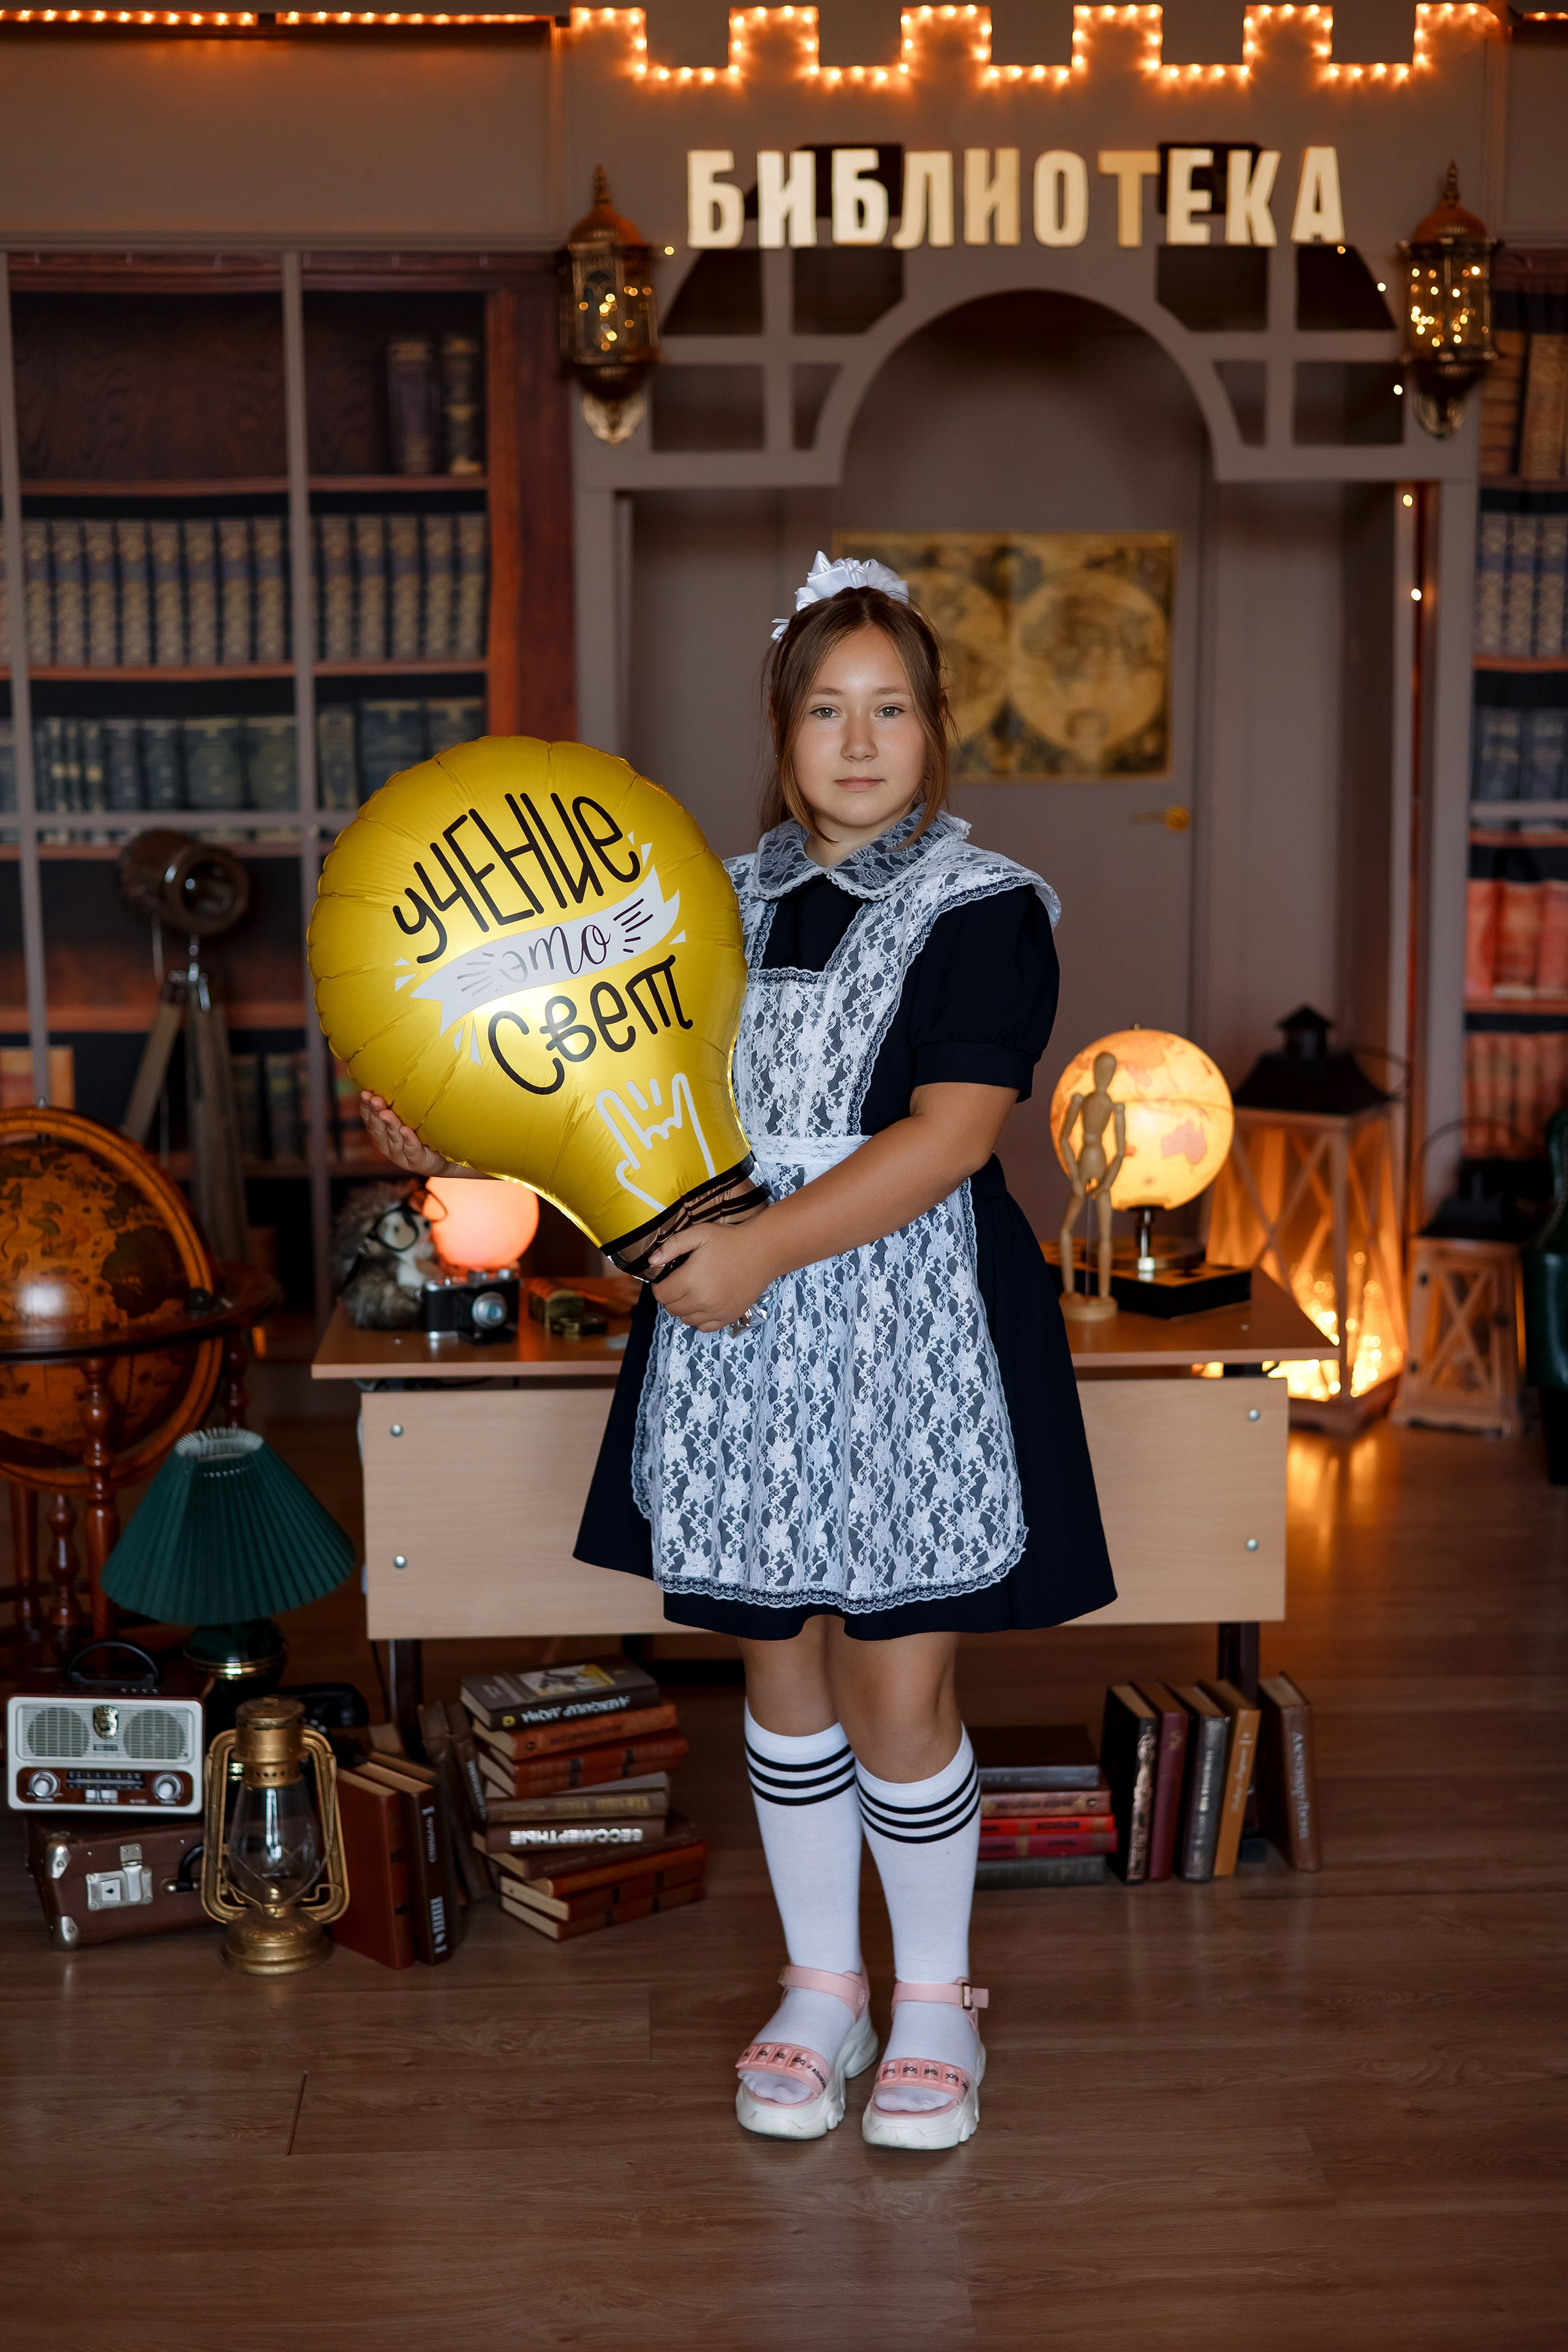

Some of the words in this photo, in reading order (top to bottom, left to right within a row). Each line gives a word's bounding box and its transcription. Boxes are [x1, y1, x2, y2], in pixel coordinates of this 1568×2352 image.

[687, 147, 1344, 248] БИБЛИОТЕКА
[498, 923, 611, 982] это
[488, 954, 694, 1095] Свет
[509, 1827, 644, 1846] БЕССМЕРТНЫЕ
